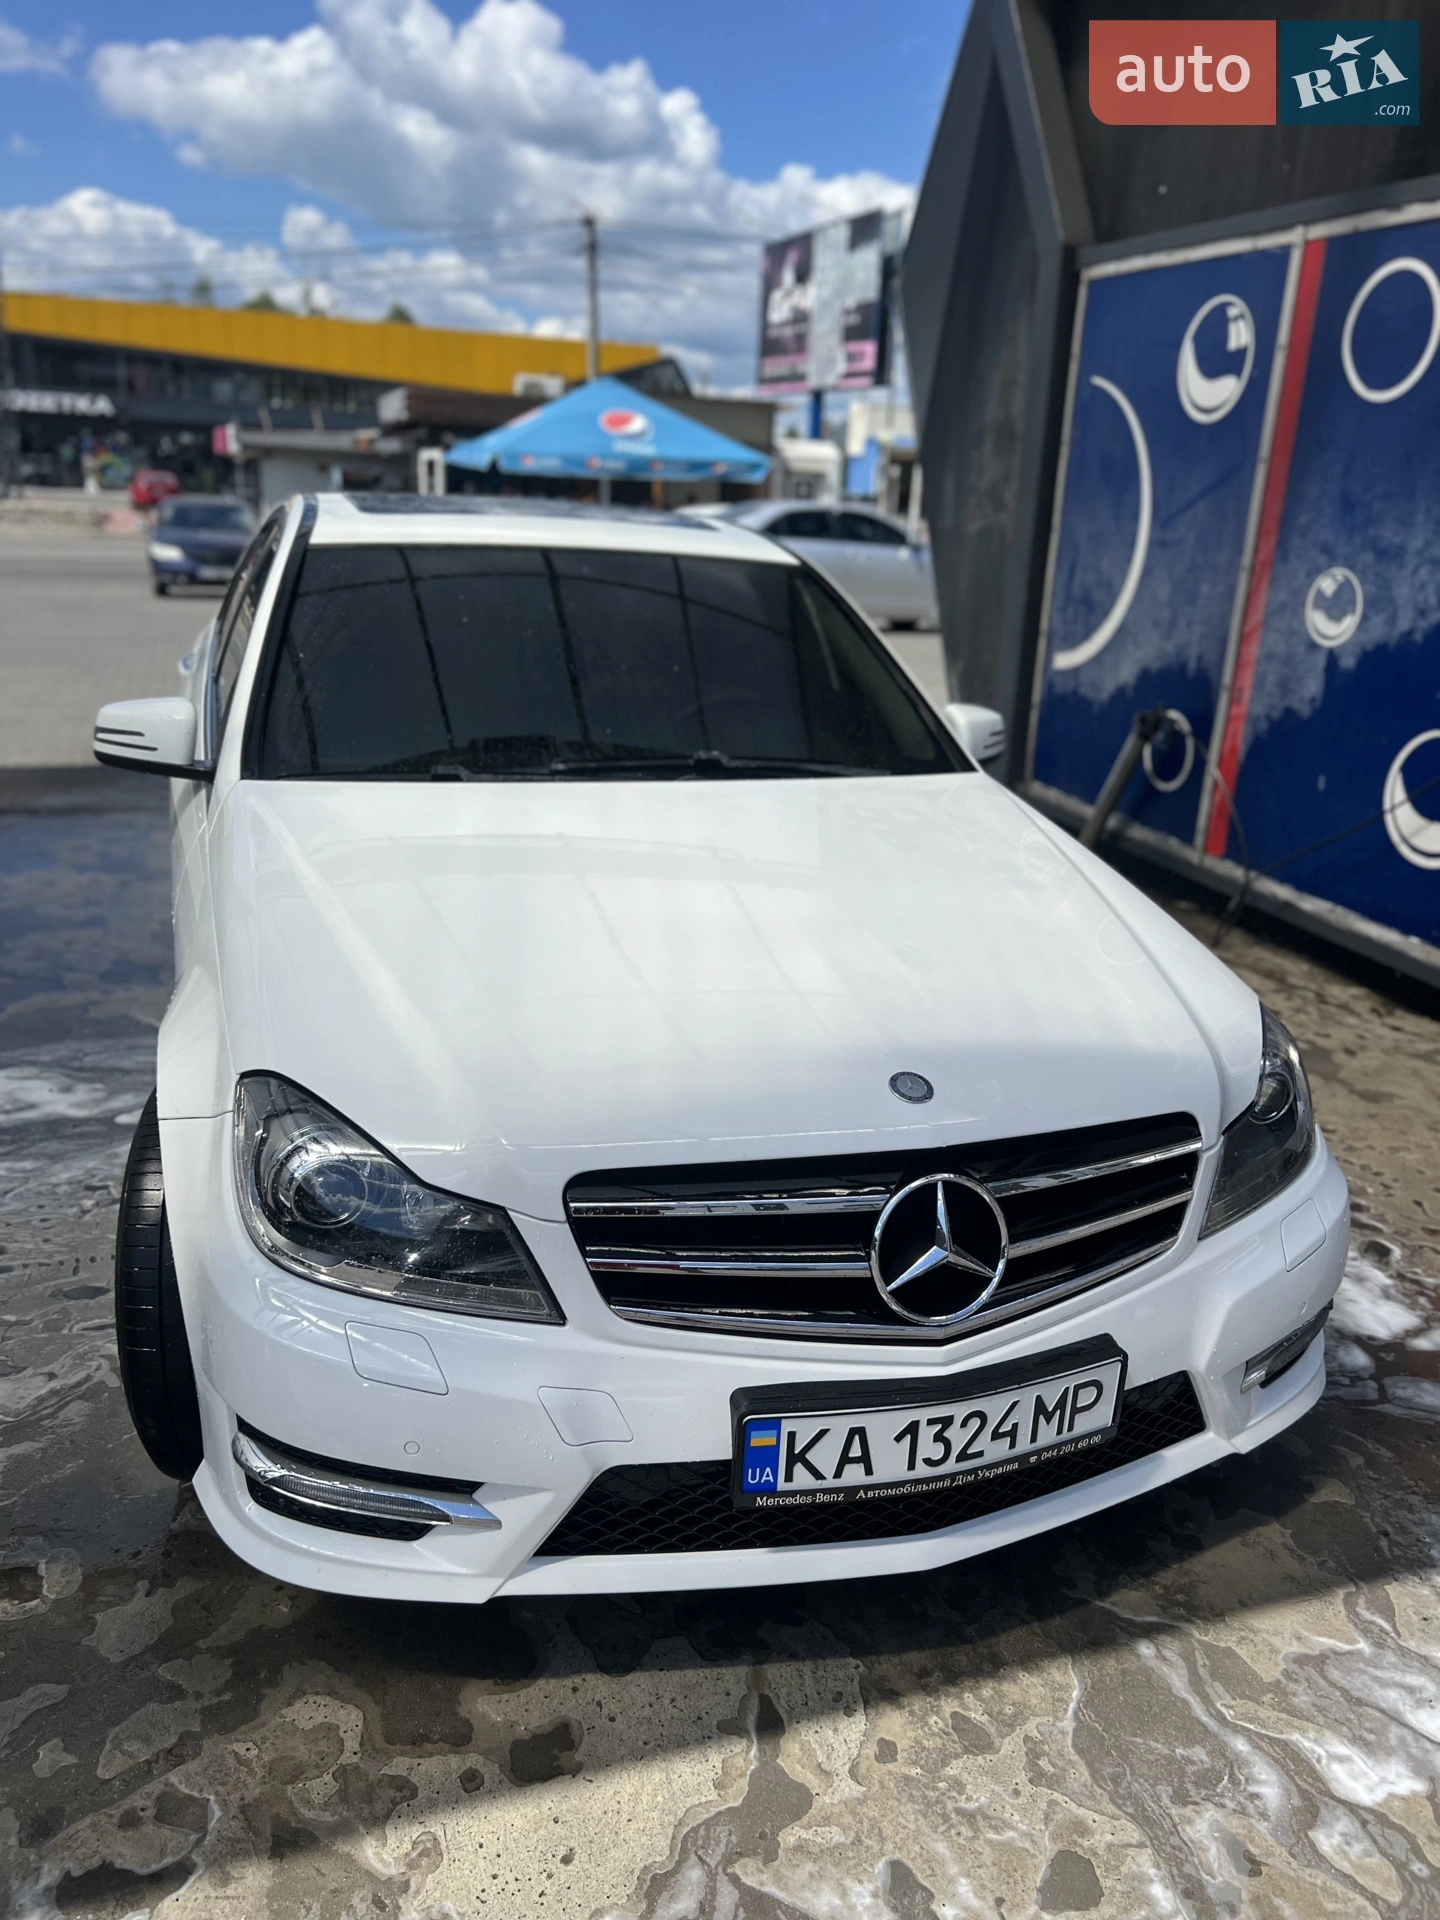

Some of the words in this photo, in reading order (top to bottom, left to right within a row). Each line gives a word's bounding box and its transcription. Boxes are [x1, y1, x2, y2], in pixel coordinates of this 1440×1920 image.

[783, 1426, 874, 1483] KA
[893, 1400, 1019, 1472] 1324
[1029, 1378, 1104, 1445] MP
[747, 1467, 775, 1484] UA
[755, 1492, 845, 1507] Mercedes-Benz
[855, 1477, 951, 1499] Автомобільний
[953, 1473, 975, 1487] Дім
[977, 1461, 1019, 1480] Україна
[1041, 1449, 1058, 1461] 044
[1060, 1445, 1076, 1455] 201
[1077, 1439, 1089, 1449] 60
[1090, 1434, 1102, 1444] 00
